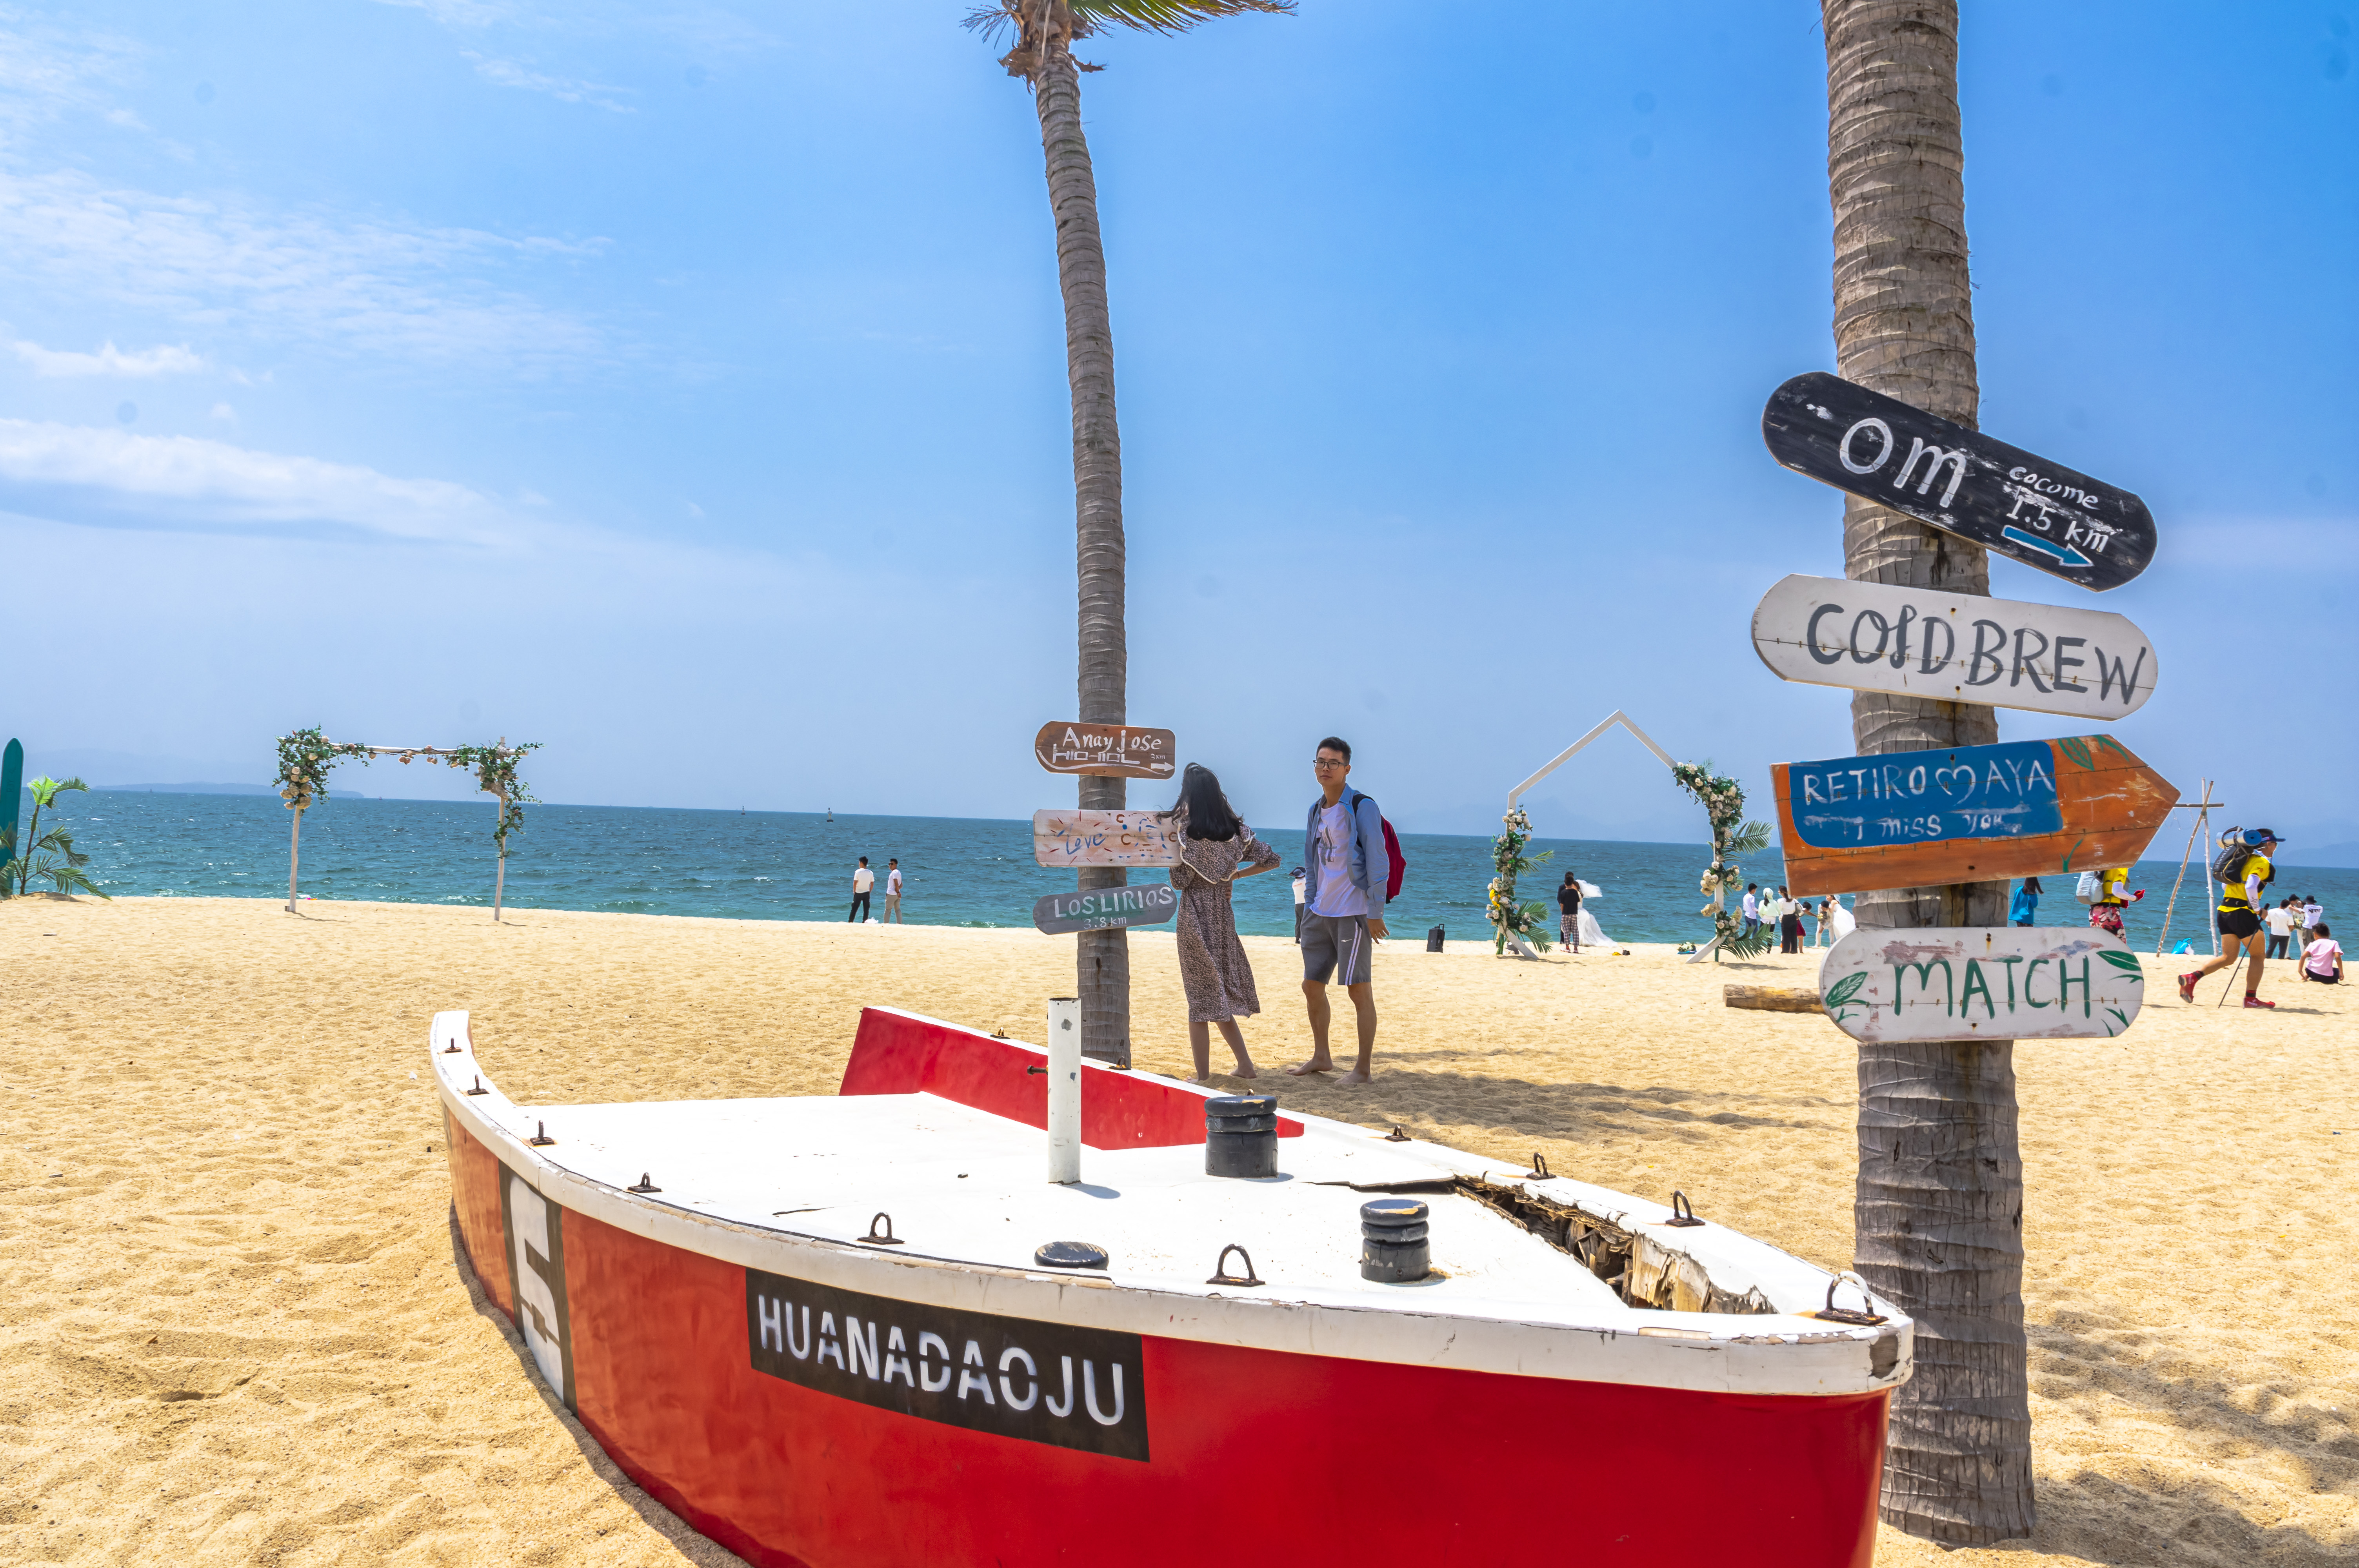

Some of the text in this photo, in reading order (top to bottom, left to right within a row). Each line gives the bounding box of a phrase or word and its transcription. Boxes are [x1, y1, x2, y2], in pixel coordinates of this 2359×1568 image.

[2065, 521, 2109, 552] km
[1964, 619, 2147, 706] BREW
[1803, 764, 1926, 806] RETIRO
[1054, 886, 1174, 918] LOS LIRIOS
[1893, 955, 2092, 1019] MATCH
[758, 1294, 1125, 1426] HUANADAOJU
